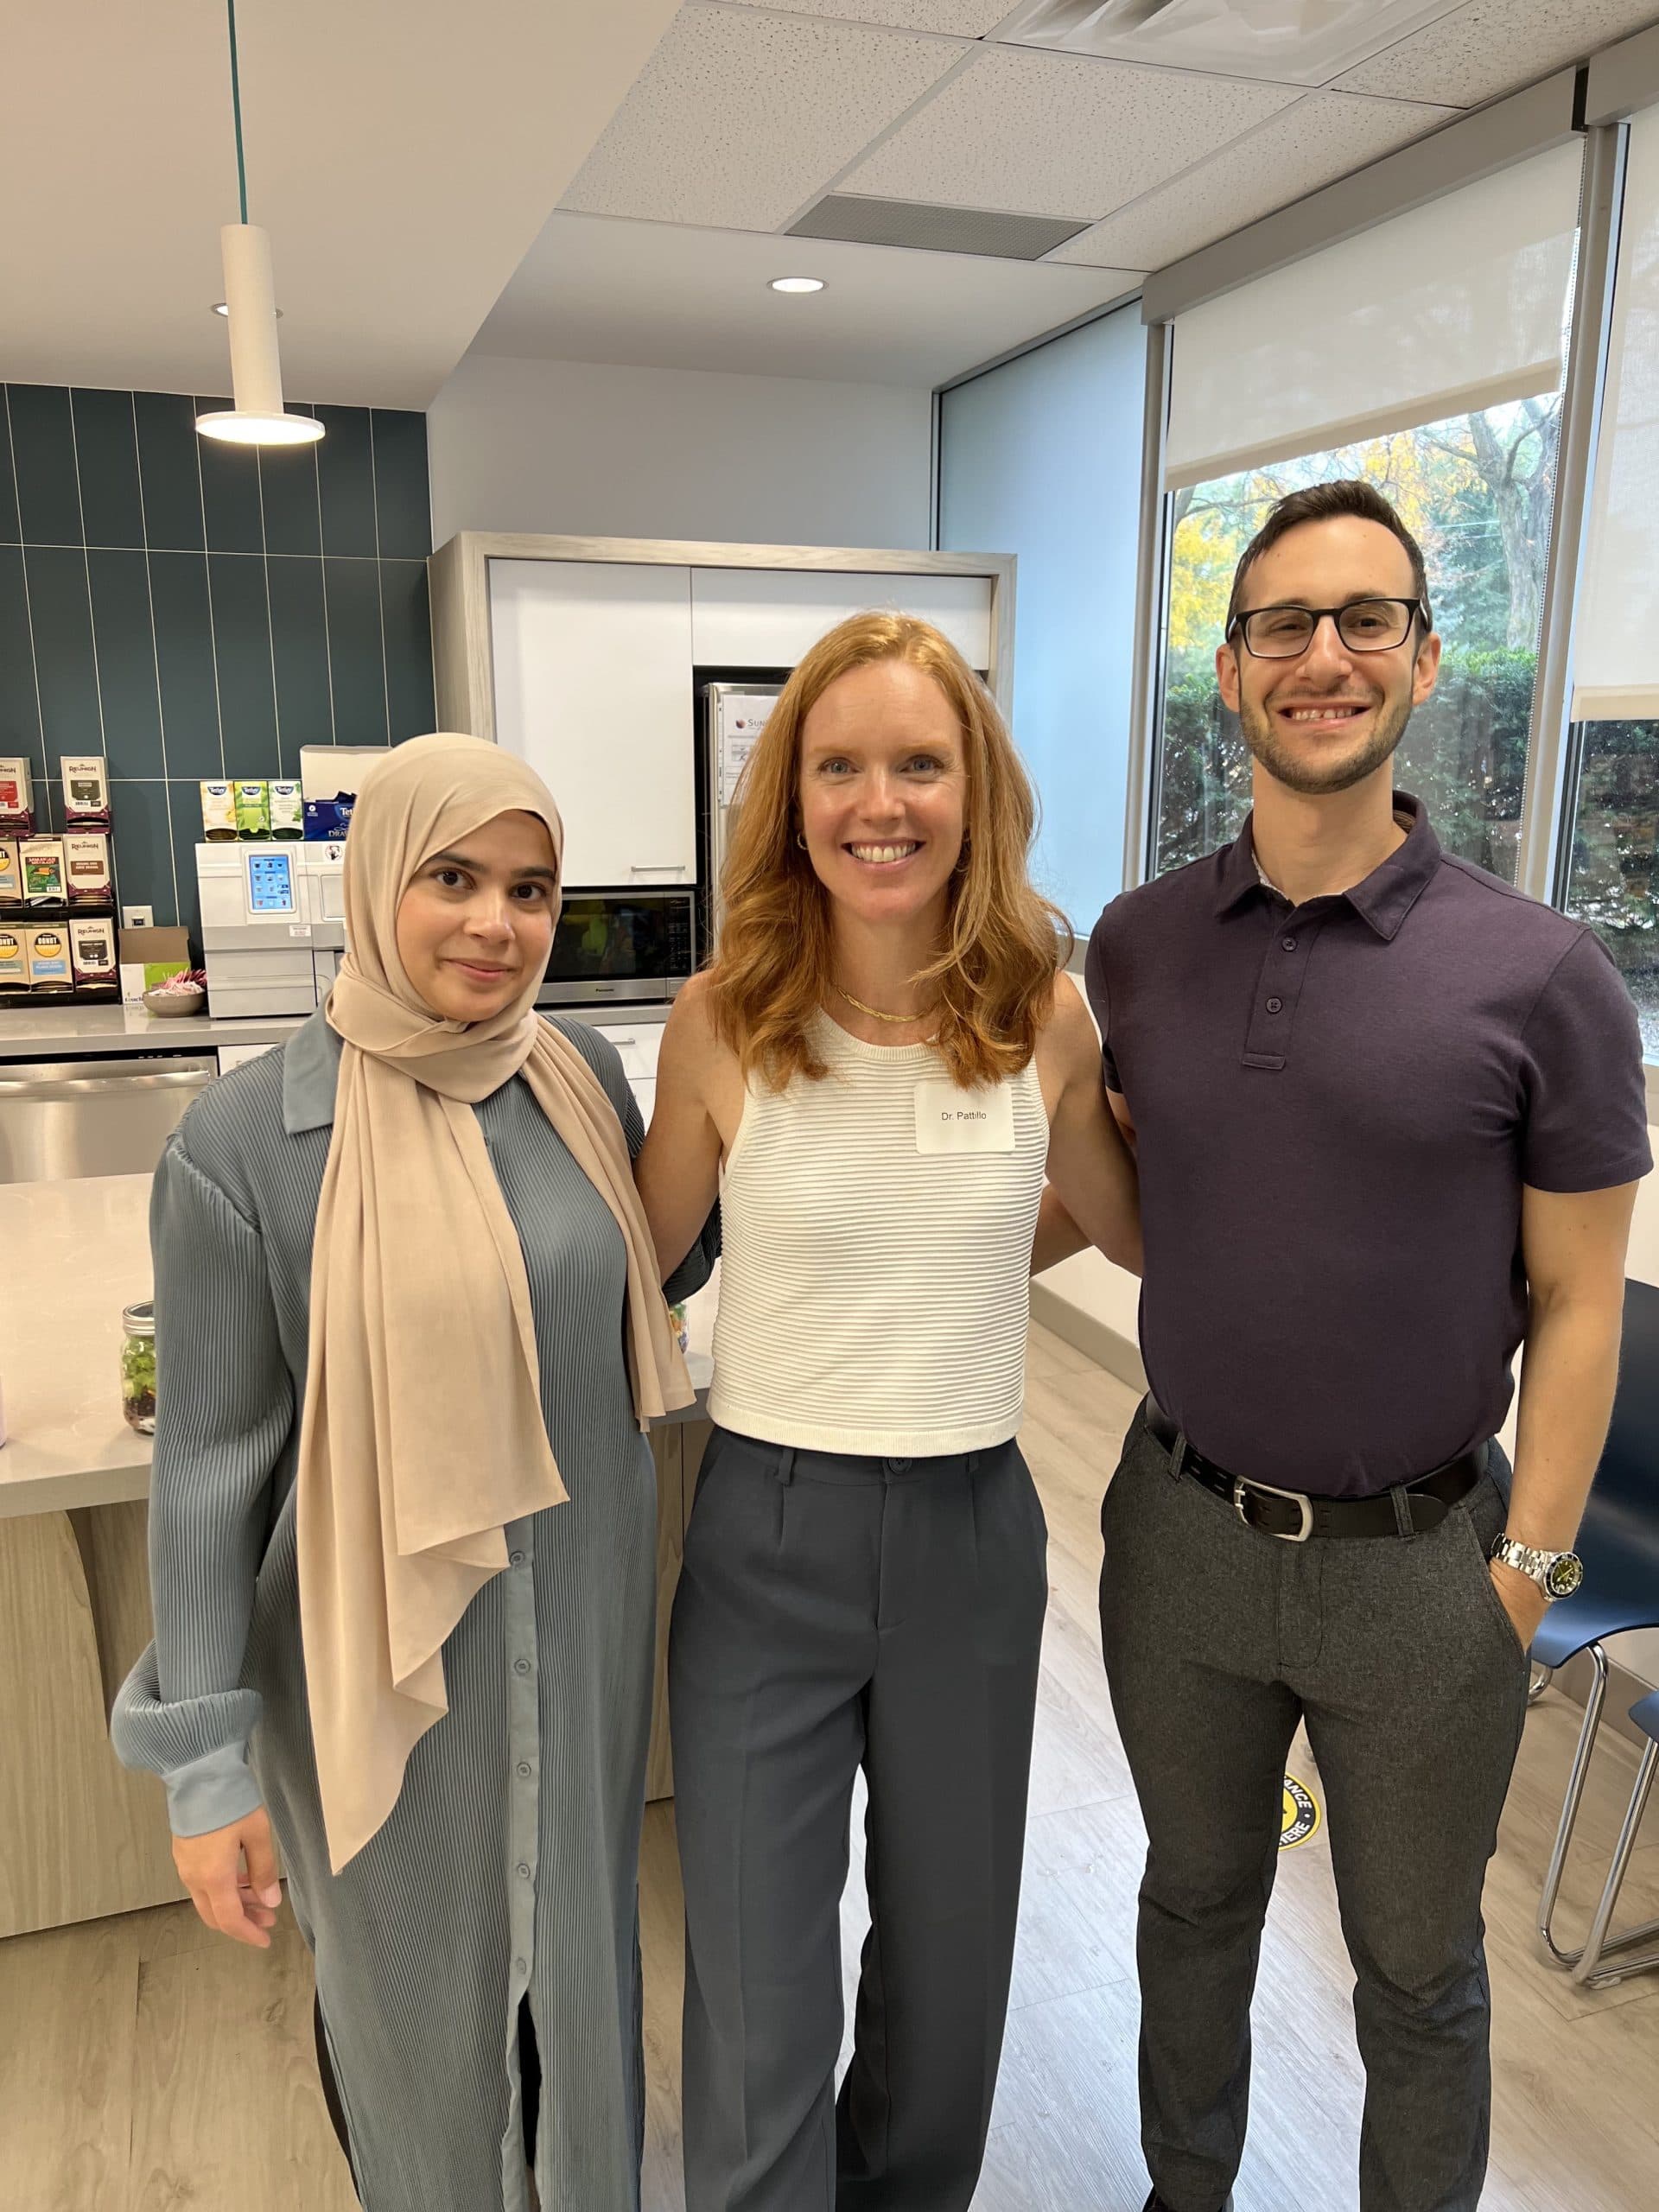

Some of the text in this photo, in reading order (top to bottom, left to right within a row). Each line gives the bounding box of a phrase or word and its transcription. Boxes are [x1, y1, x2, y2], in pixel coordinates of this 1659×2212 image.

[941, 1111, 987, 1121] Dr. Pattillo
[1284, 1777, 1313, 1808] ANCE
